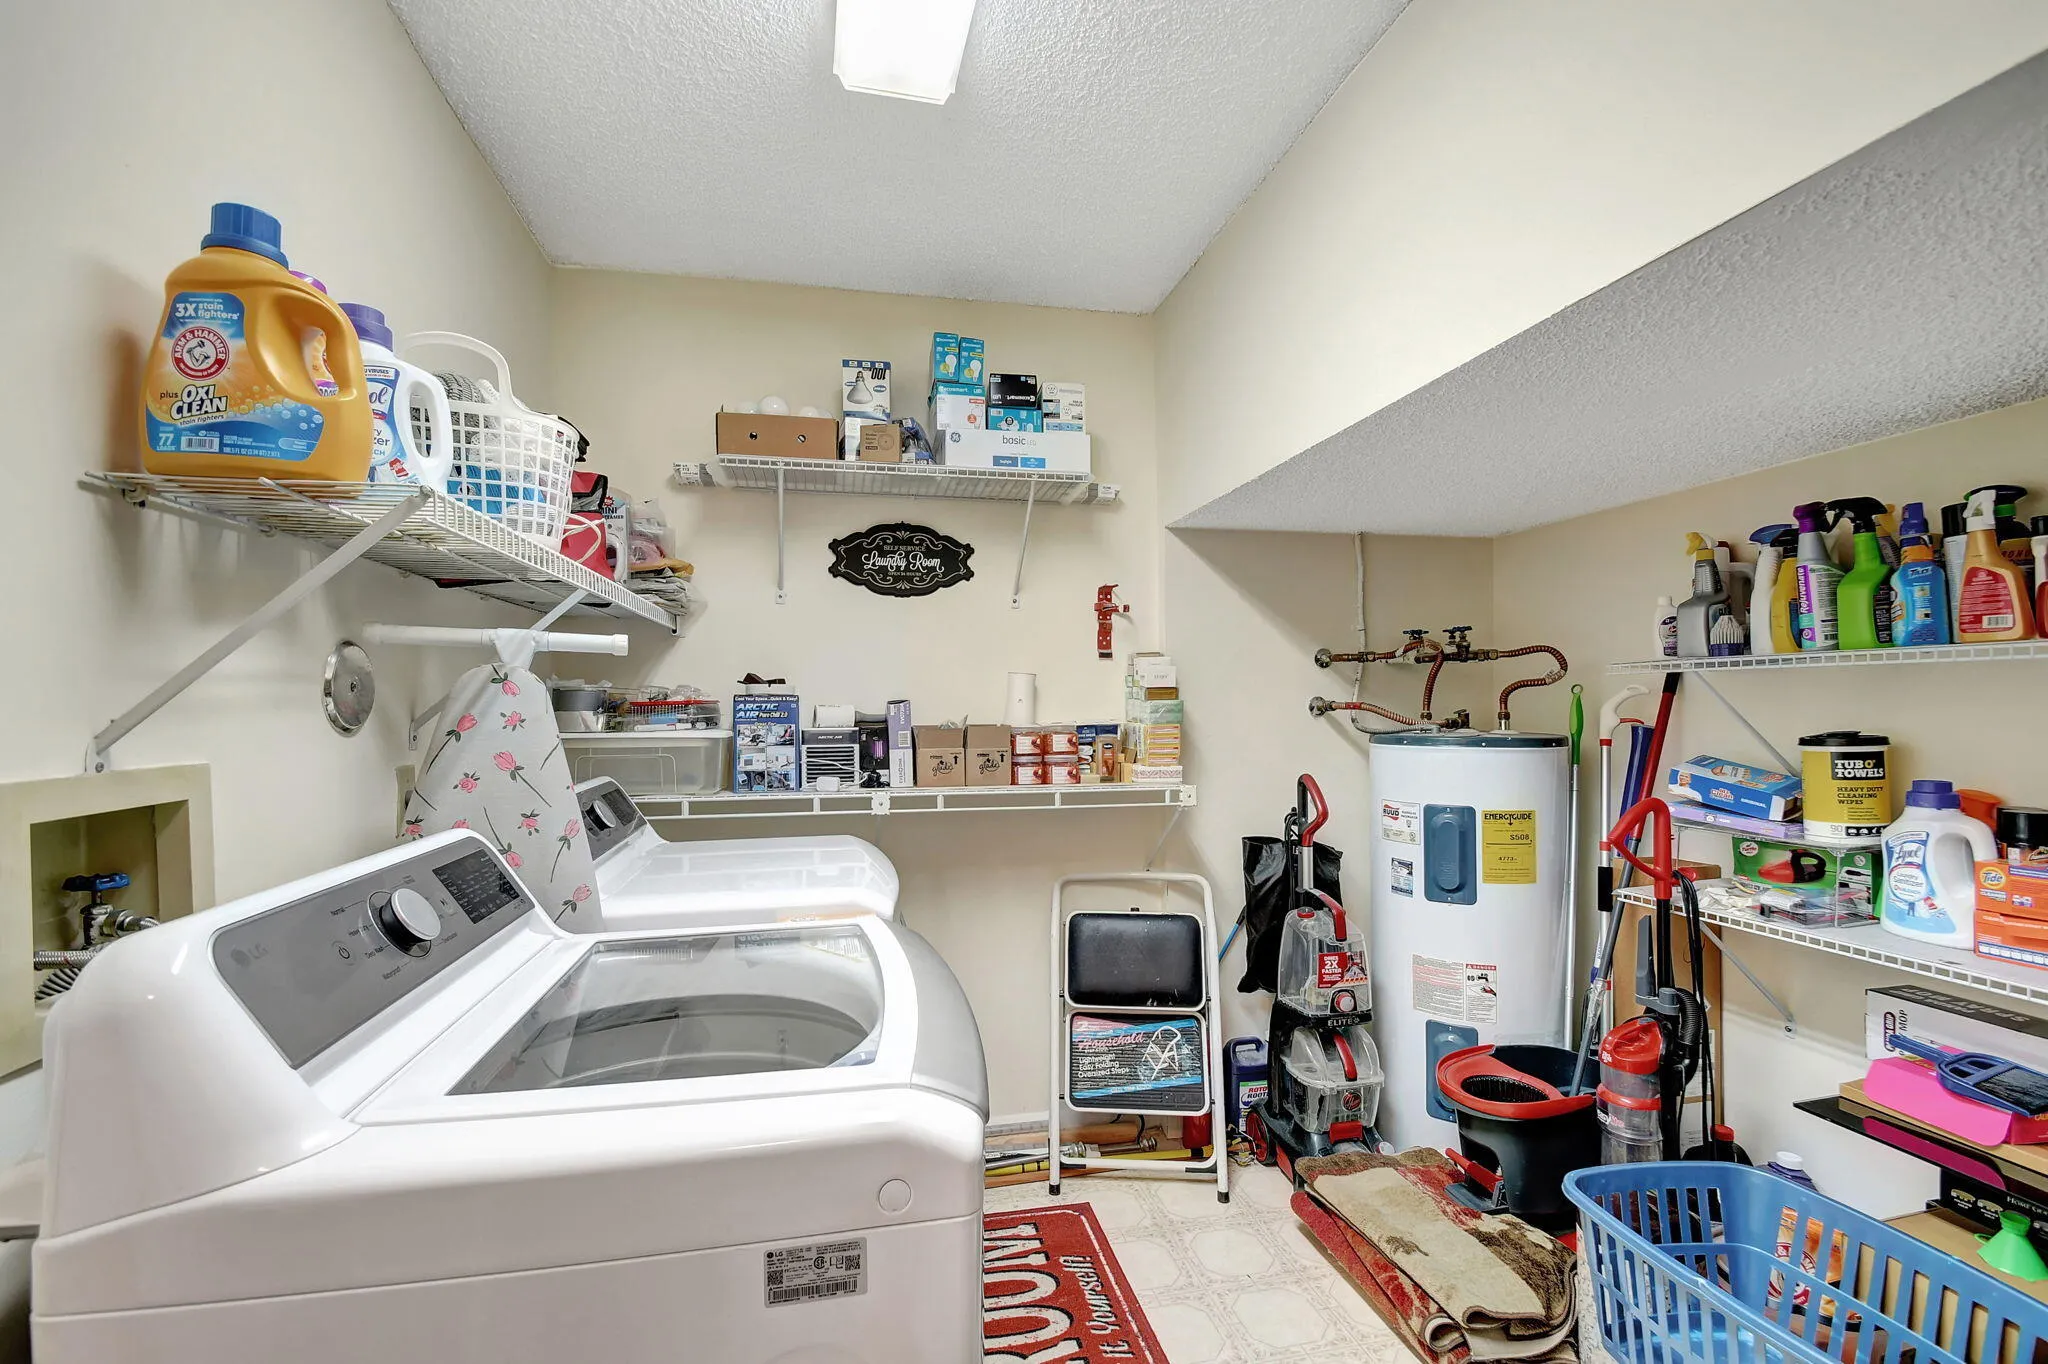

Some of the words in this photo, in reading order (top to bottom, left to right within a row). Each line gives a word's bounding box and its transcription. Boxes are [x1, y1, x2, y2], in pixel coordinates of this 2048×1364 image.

[175, 303, 197, 317] 3X
[198, 303, 224, 311] stain
[174, 337, 187, 358] ARM
[185, 331, 194, 341] &
[194, 329, 226, 360] HAMMER
[871, 368, 886, 380] 100
[160, 391, 179, 400] plus
[181, 384, 216, 403] OXI
[170, 397, 228, 420] CLEAN
[158, 433, 174, 446] 77
[1002, 435, 1026, 446] basic
[862, 550, 907, 572] Laundry
[909, 552, 945, 573] Room
[1797, 567, 1810, 613] Rejuvenate
[736, 703, 779, 711] ARCTIC
[736, 711, 759, 719] AIR
[931, 760, 954, 777] glade
[979, 759, 1001, 775] glade
[1834, 760, 1864, 769] TUB
[1834, 768, 1884, 778] TOWELS
[1383, 808, 1399, 816] RUUD
[1484, 812, 1533, 821] ENERGYGUIDE
[1982, 871, 2003, 883] Tide
[1324, 961, 1339, 969] 2X
[1950, 1001, 2031, 1022] SPRAY
[1327, 1017, 1353, 1026] ELITE
[1898, 1009, 1908, 1032] MOP
[1079, 1063, 1095, 1071] Easy
